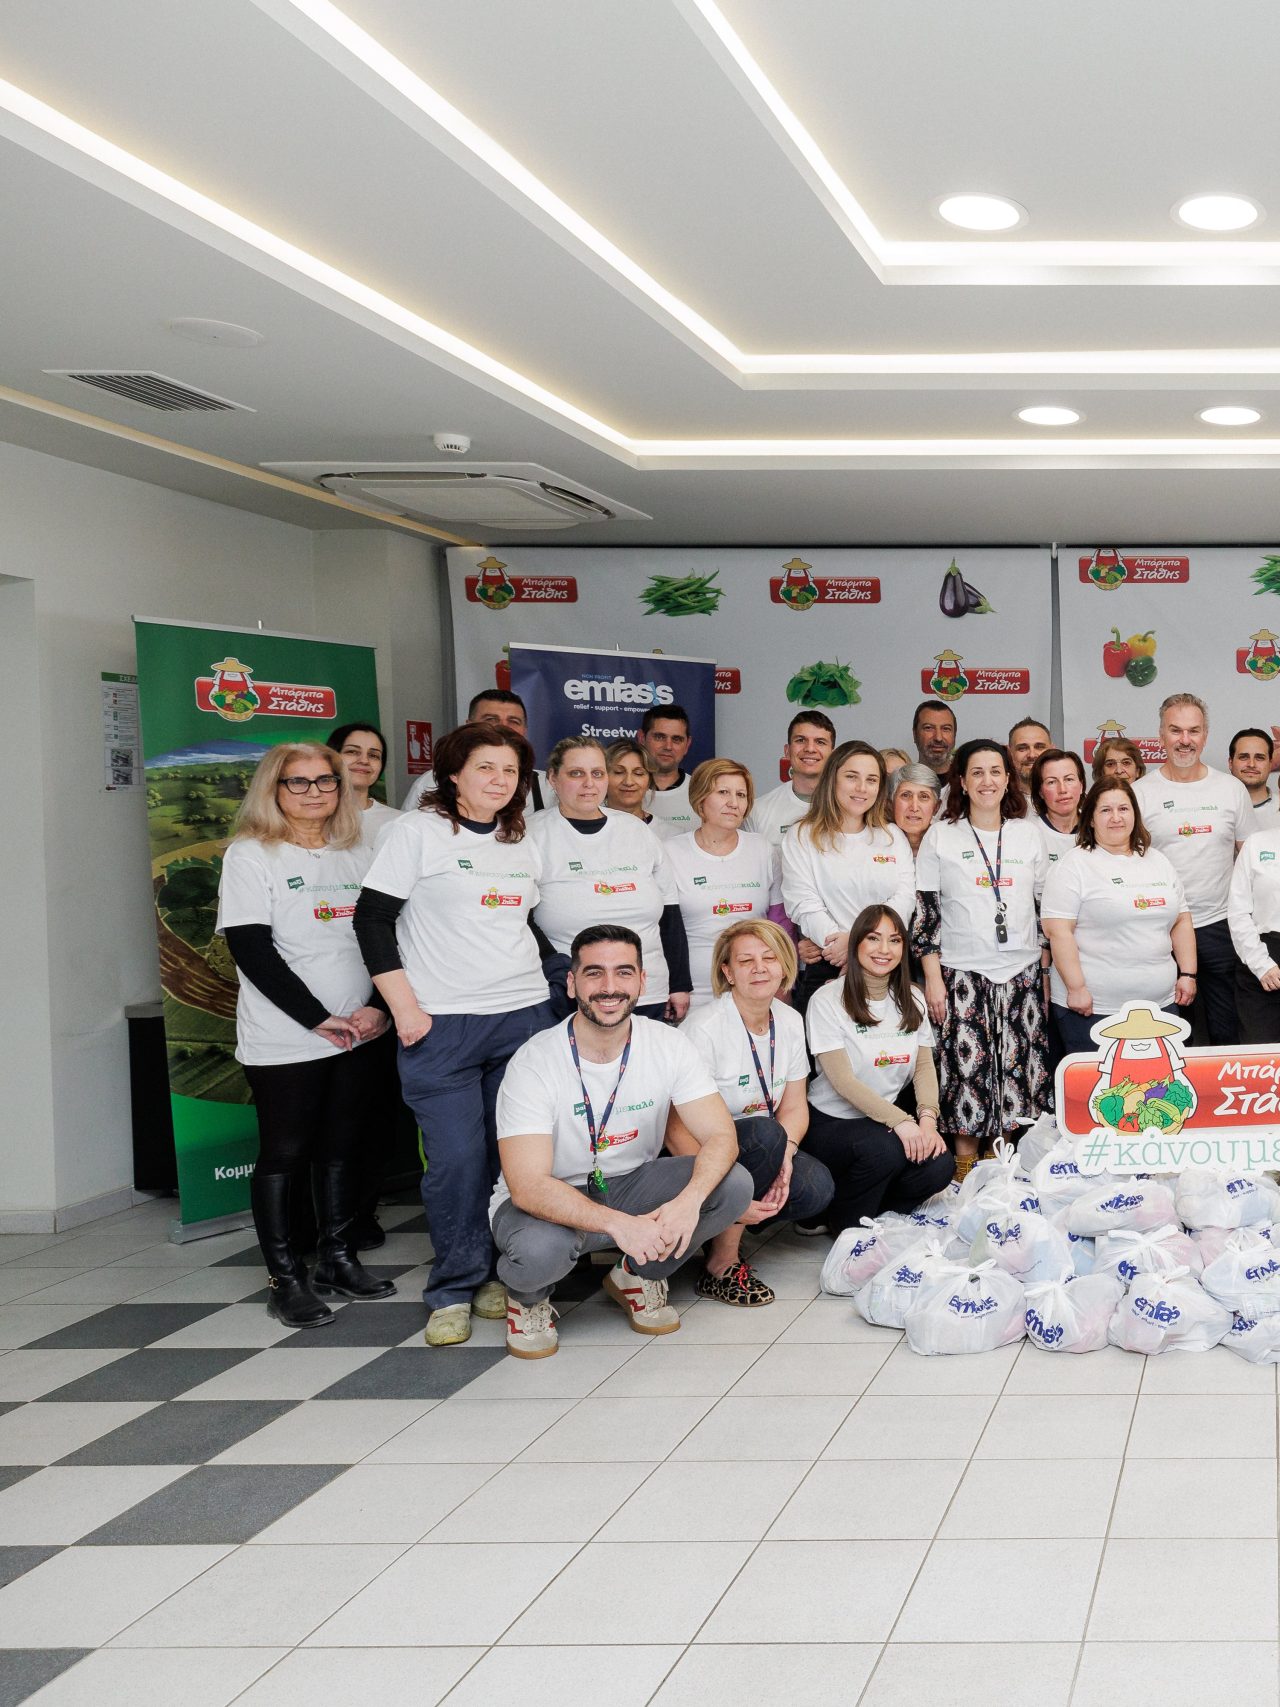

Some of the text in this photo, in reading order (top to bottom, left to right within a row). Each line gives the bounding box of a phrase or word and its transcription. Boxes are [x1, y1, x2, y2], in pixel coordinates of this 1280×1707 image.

[1135, 558, 1180, 570] Μπάρμπα
[1133, 567, 1180, 580] Στάθης
[521, 577, 568, 589] Μπάρμπα
[825, 578, 872, 590] Μπάρμπα
[521, 587, 568, 600] Στάθης
[824, 588, 872, 600] Στάθης
[976, 670, 1021, 681] Μπάρμπα
[974, 679, 1021, 691] Στάθης
[269, 686, 324, 701] Μπάρμπα
[267, 697, 324, 713] Στάθης
